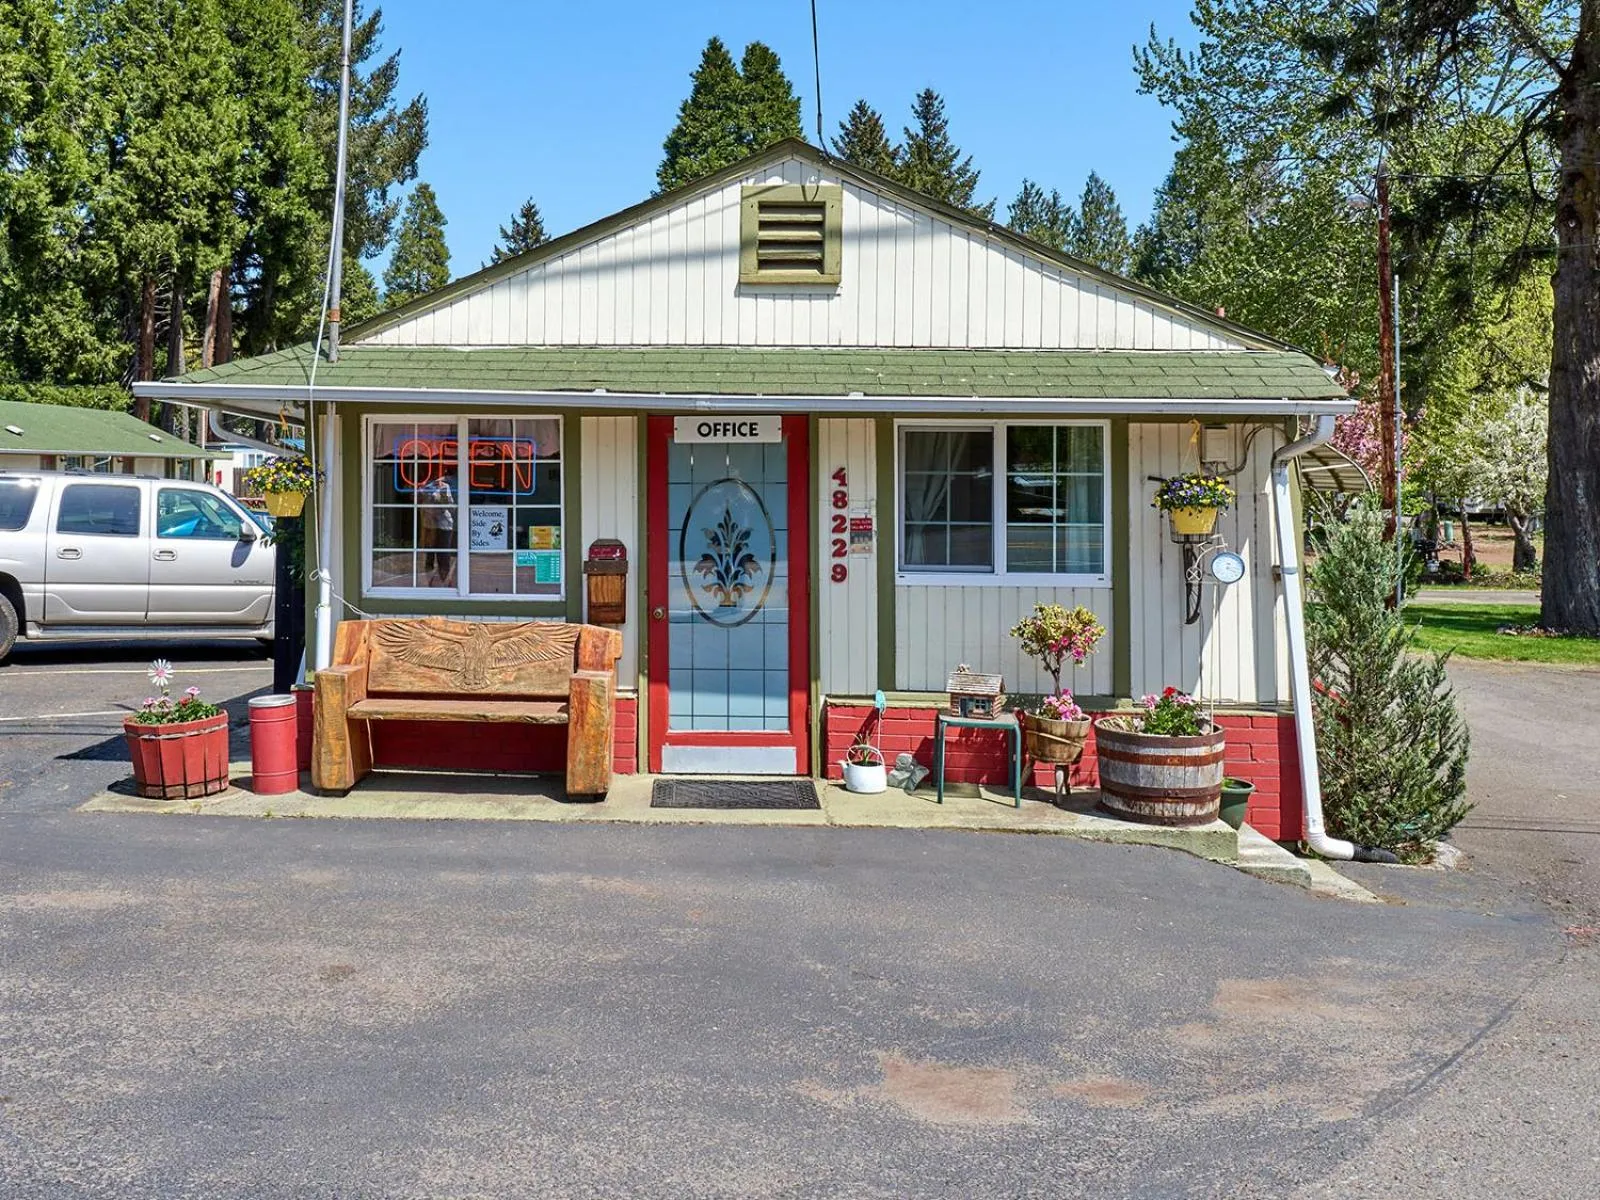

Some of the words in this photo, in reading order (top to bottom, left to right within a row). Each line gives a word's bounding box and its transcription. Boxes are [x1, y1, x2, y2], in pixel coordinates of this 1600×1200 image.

[697, 421, 759, 438] OFFICE
[400, 439, 532, 489] OPEN
[472, 519, 487, 527] Side
[831, 466, 848, 584] 48229
[472, 529, 482, 538] By
[471, 539, 490, 547] Sides
